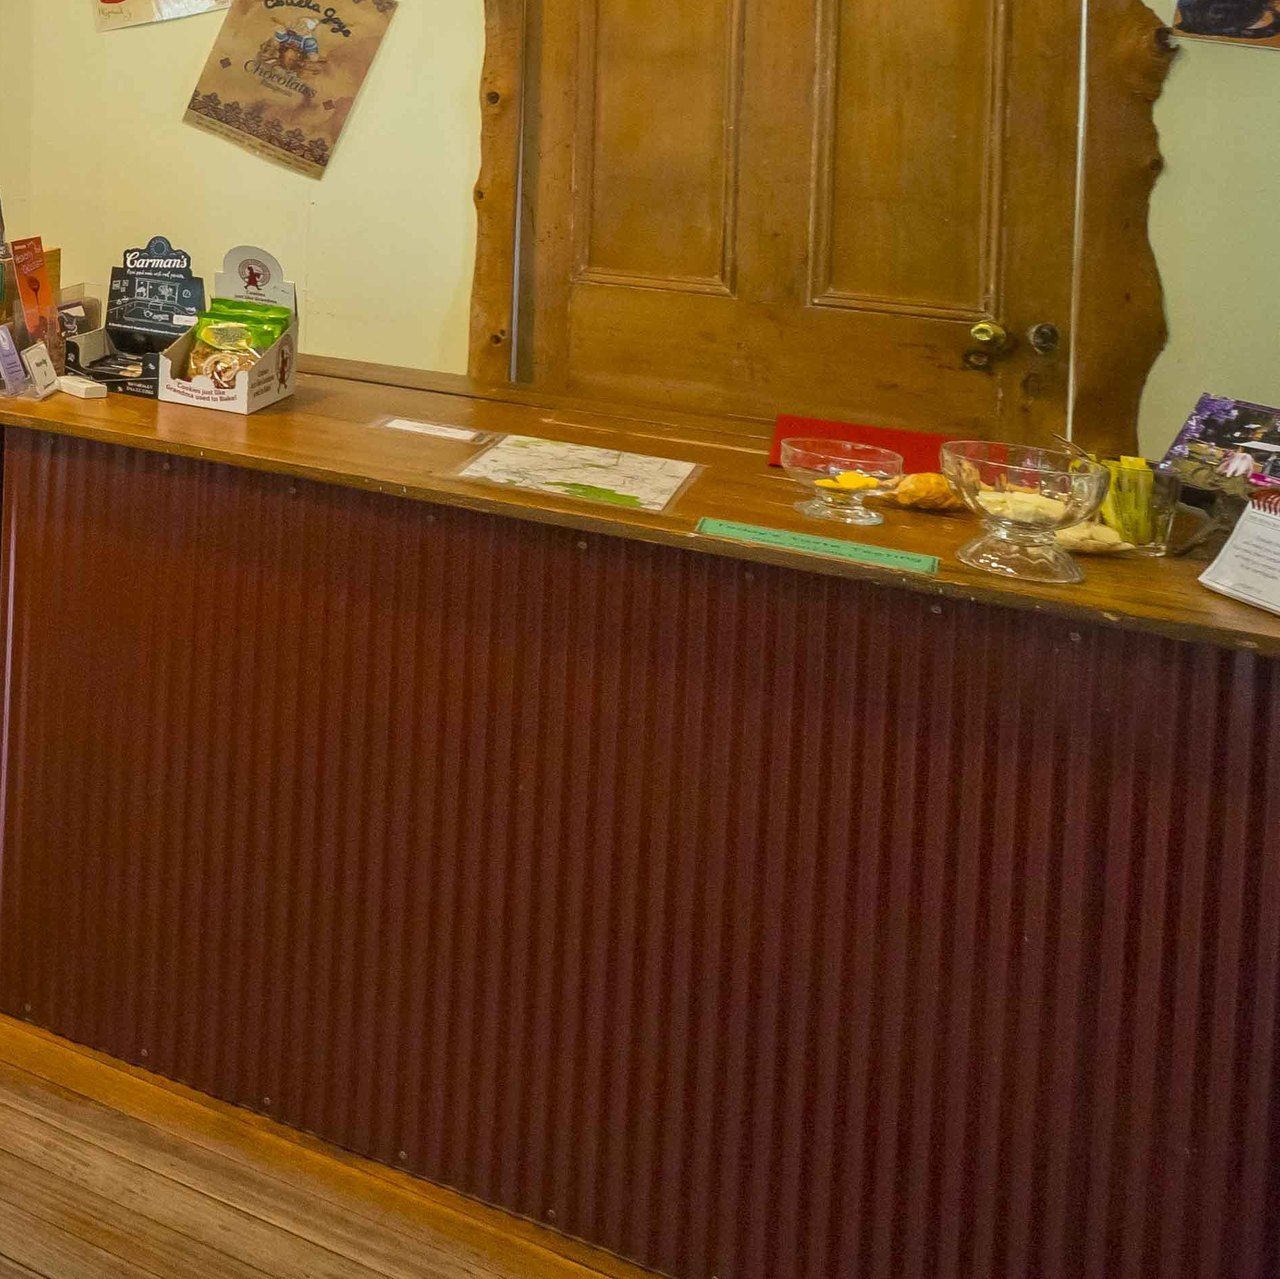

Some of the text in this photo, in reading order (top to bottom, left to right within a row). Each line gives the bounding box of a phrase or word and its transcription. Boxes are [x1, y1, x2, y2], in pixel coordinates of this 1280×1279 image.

[126, 251, 188, 269] Carman's
[166, 385, 194, 399] Grandma
[195, 393, 209, 401] used
[177, 382, 201, 395] Cookies
